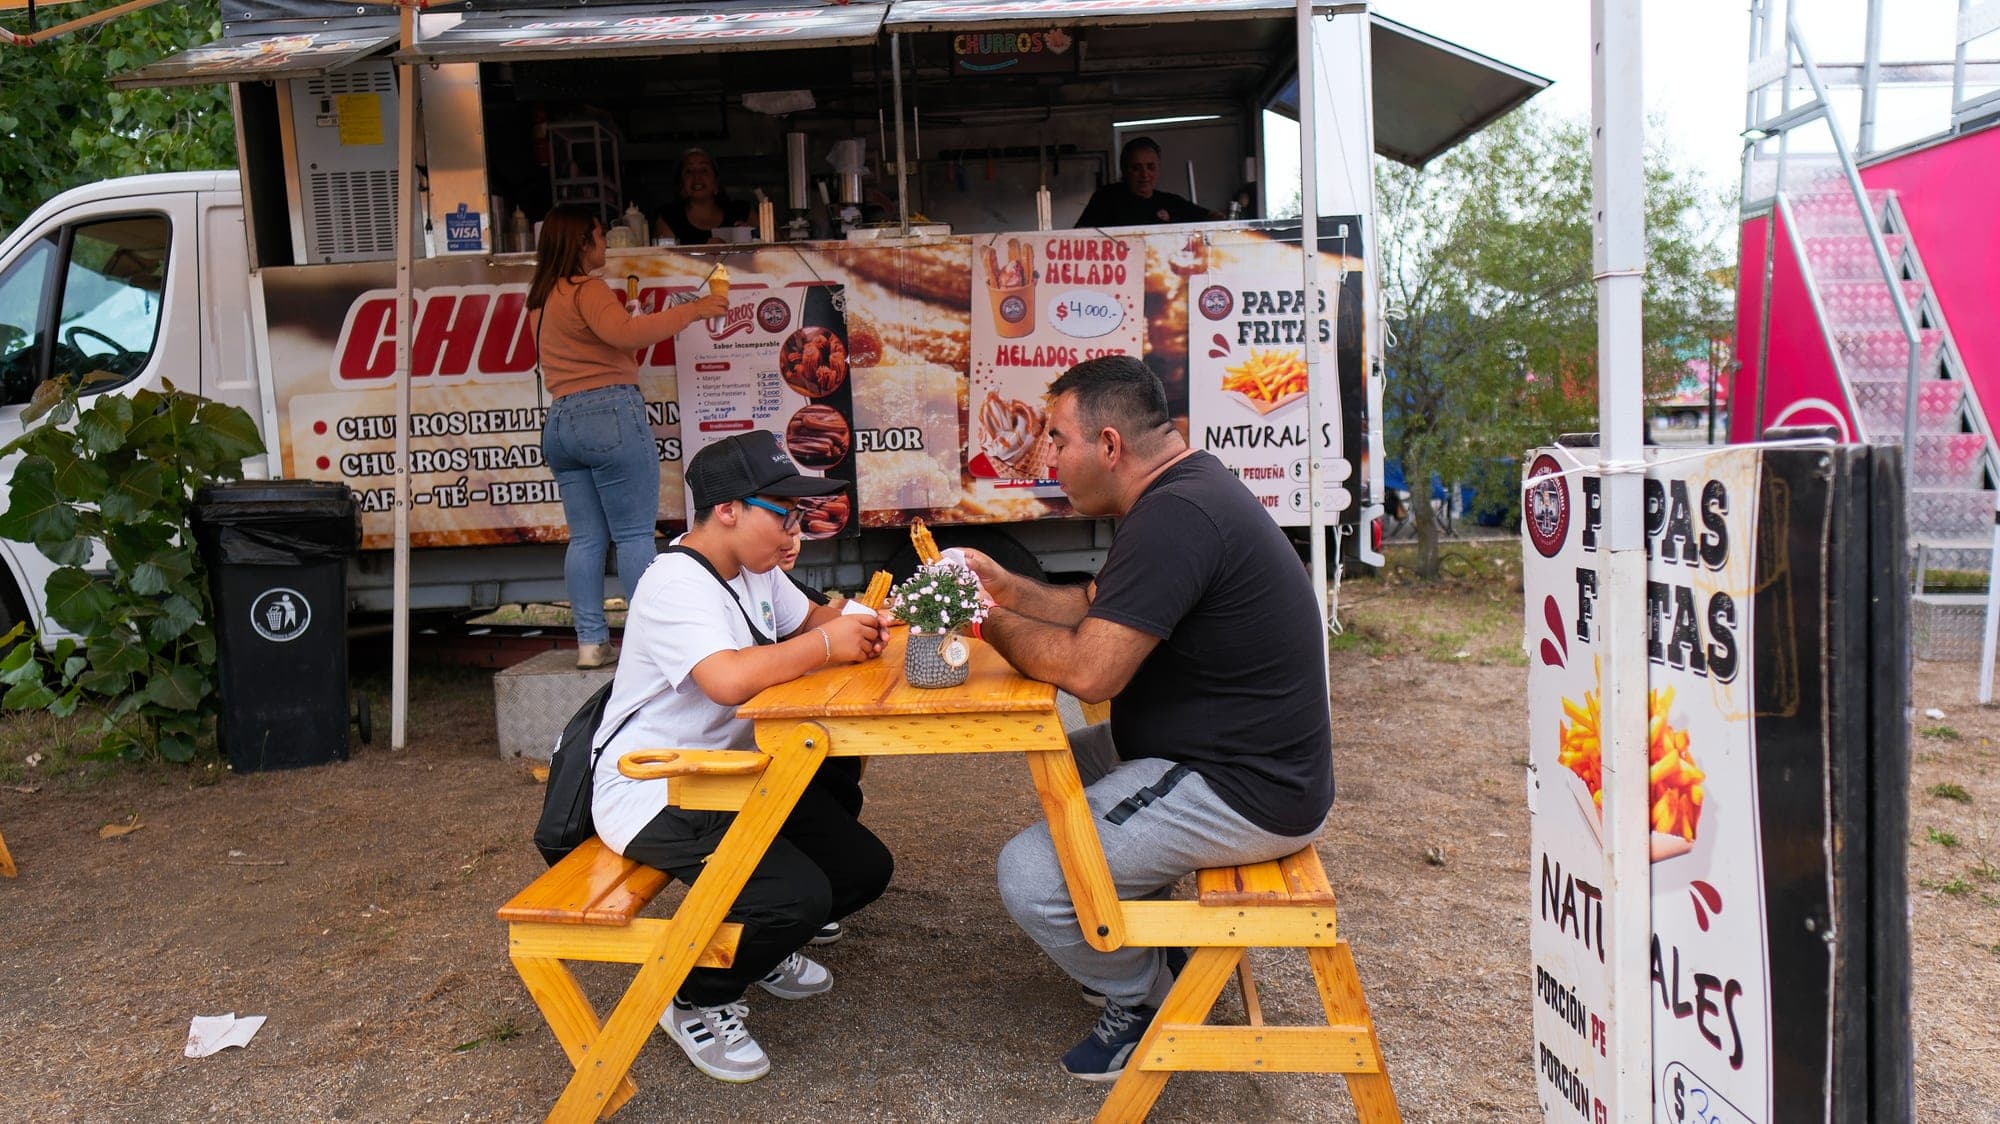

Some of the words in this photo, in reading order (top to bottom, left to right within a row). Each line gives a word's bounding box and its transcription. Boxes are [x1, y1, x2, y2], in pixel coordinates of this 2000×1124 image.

[954, 32, 1041, 55] CHURROS
[451, 227, 479, 239] VISA
[1046, 239, 1128, 261] CHURRO
[1045, 263, 1127, 285] HELADO
[735, 341, 780, 349] incomparable
[995, 344, 1079, 368] HELADOS
[1205, 421, 1331, 450] NATURALS
[1243, 463, 1285, 480] PEQUEÑA
[434, 476, 467, 507] TÉ
[1582, 476, 1728, 572] PPAS
[1537, 964, 1587, 1040] PORCIÓN
[1540, 1040, 1591, 1122] PORCIÓN
